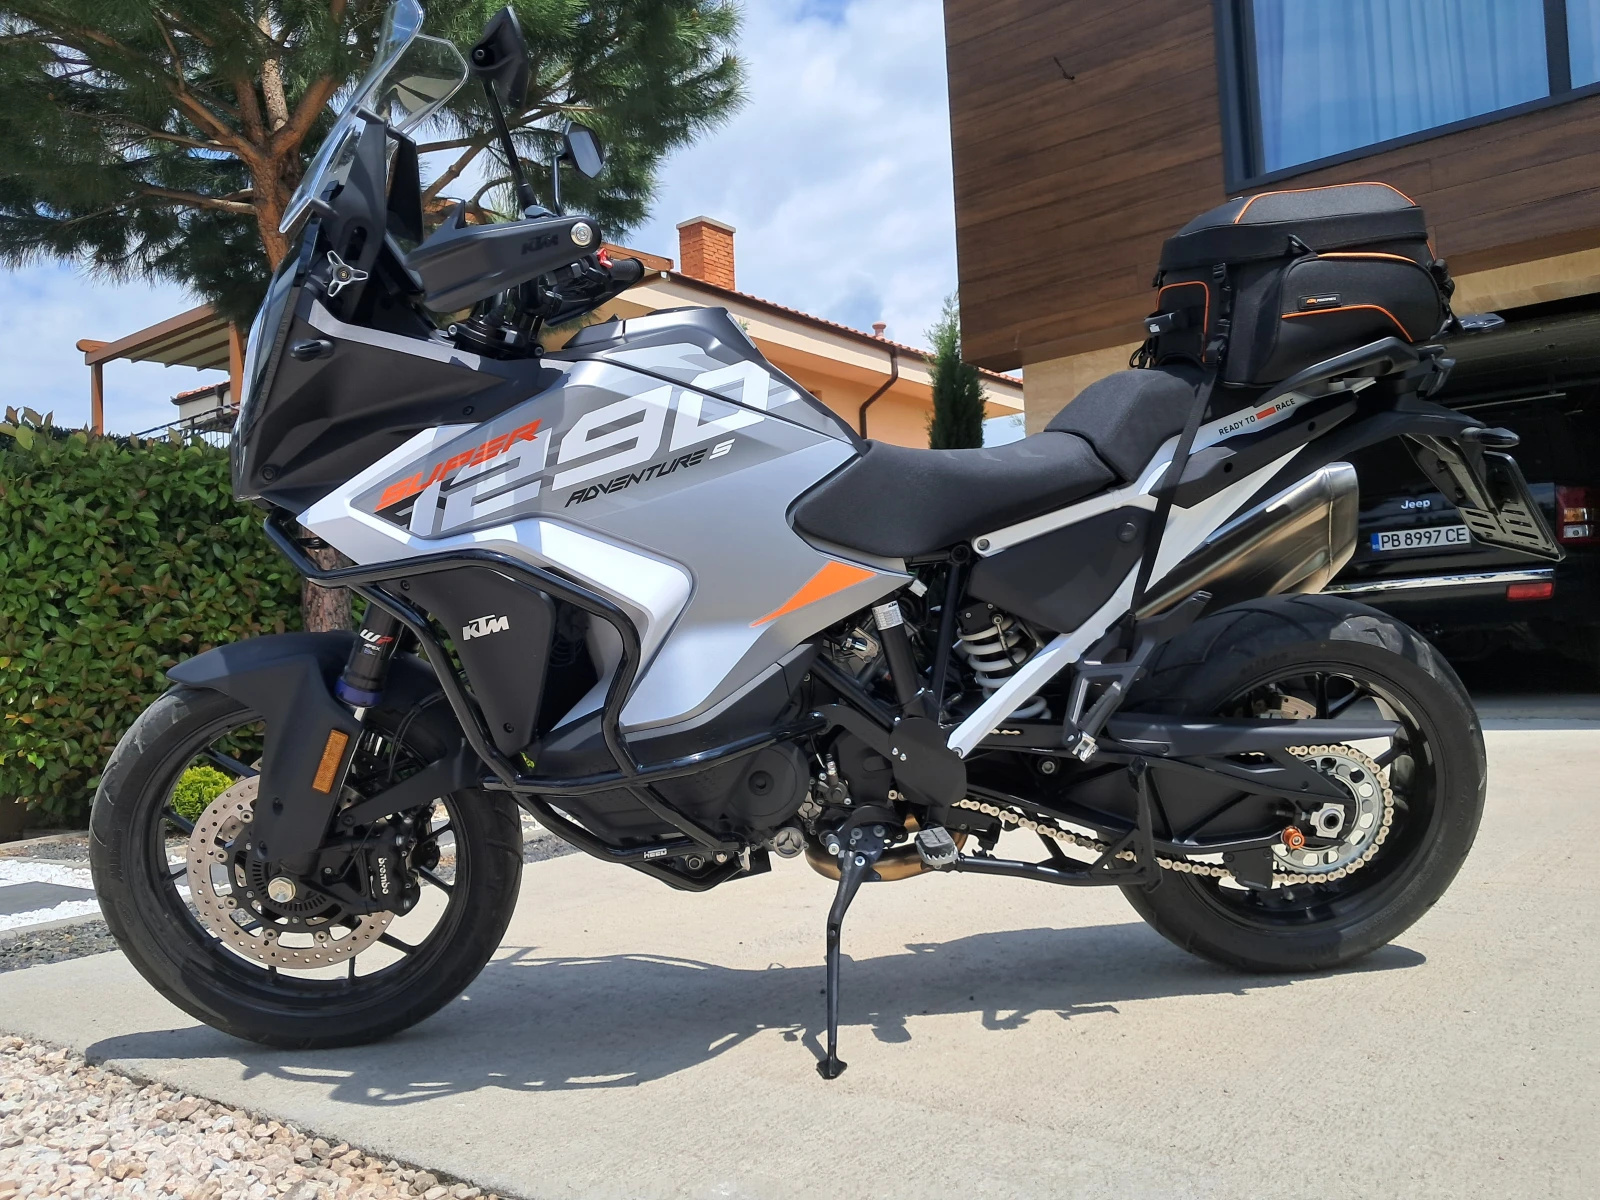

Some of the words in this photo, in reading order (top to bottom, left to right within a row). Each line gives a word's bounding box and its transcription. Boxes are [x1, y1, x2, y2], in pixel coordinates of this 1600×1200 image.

[1218, 421, 1245, 435] READY
[1245, 415, 1256, 425] TO
[1275, 398, 1296, 411] RACE
[375, 418, 543, 511] SUPER
[408, 360, 771, 536] 1290
[564, 448, 708, 508] ADVENTURE
[709, 438, 735, 460] S
[1400, 499, 1431, 510] Jeep
[1381, 533, 1401, 549] PB
[1404, 529, 1442, 546] 8997
[1445, 527, 1467, 543] CE
[462, 614, 510, 641] KTM
[377, 857, 391, 895] brembo
